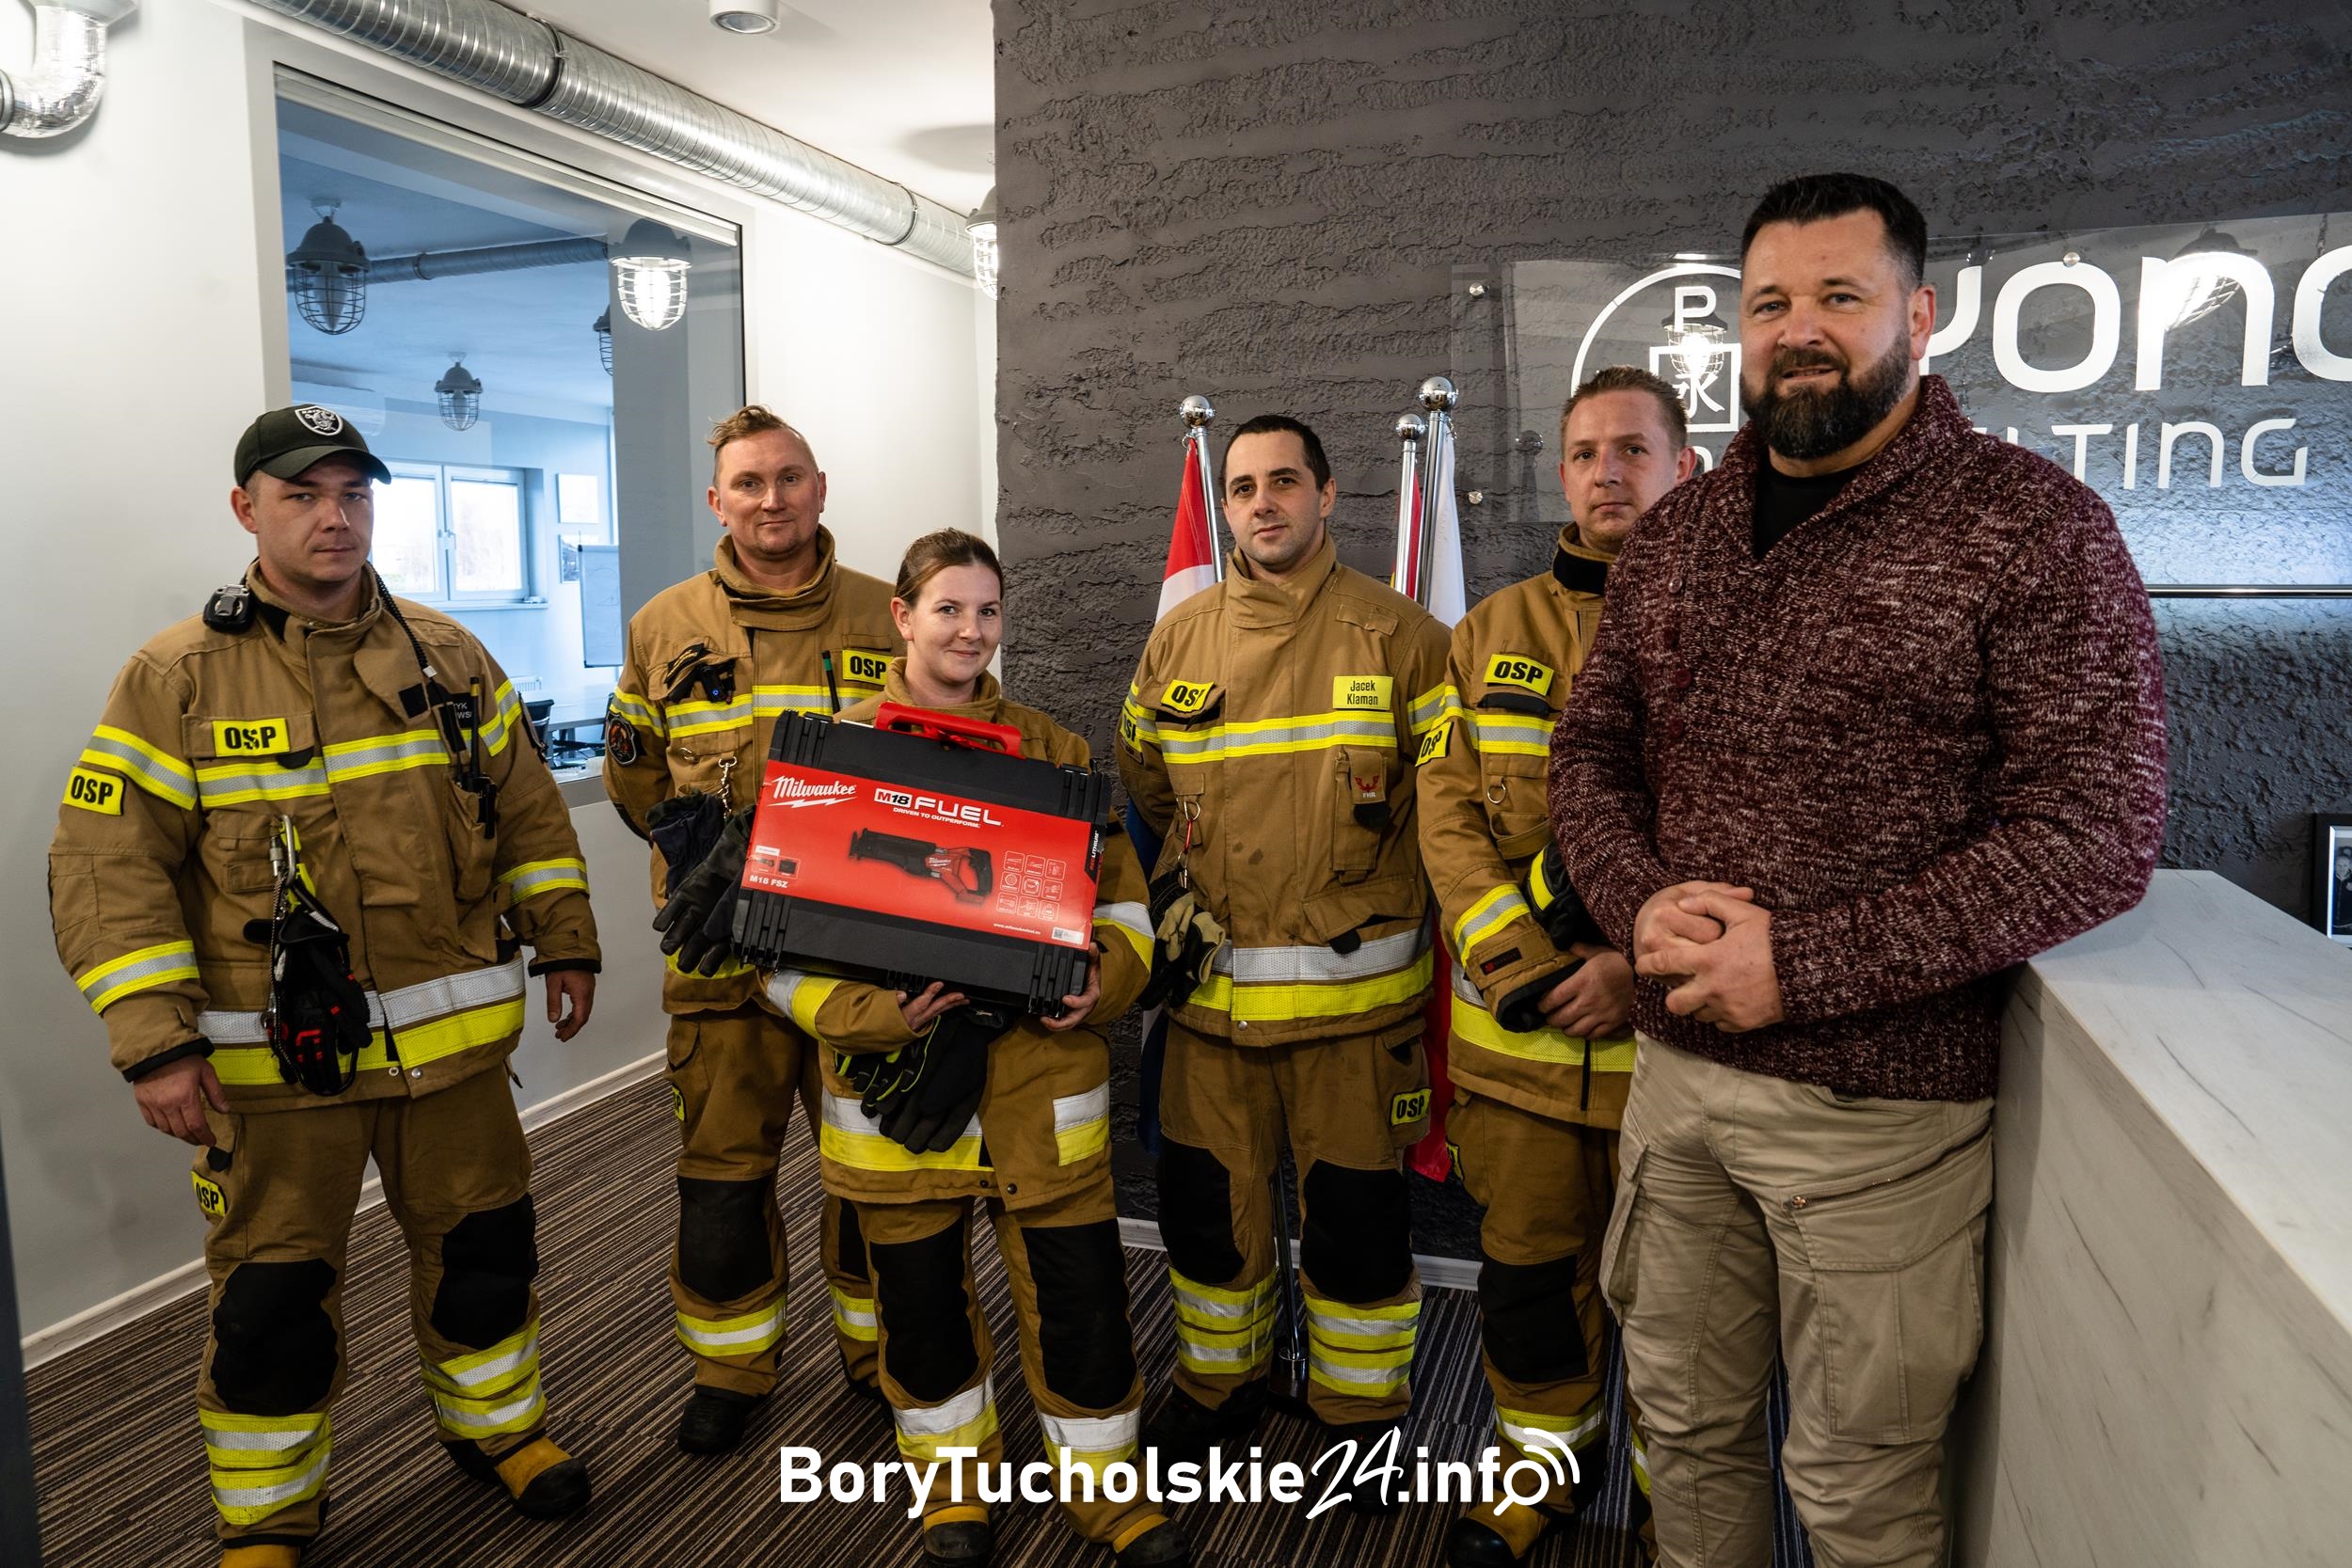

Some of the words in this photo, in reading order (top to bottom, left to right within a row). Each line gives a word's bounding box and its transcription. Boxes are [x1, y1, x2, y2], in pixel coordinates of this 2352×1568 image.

[1674, 285, 1717, 332] P
[850, 656, 886, 679] OSP
[1493, 660, 1544, 684] OSP
[1350, 680, 1375, 691] Jacek
[1347, 693, 1378, 705] Klaman
[224, 726, 277, 750] OSP
[71, 774, 114, 805] OSP
[771, 775, 856, 799] Milwaukee
[878, 791, 910, 805] M18
[914, 797, 1002, 826] FUEL
[893, 807, 919, 816] DRIVEN
[771, 879, 788, 888] FSZ
[1396, 1095, 1424, 1119] OSP
